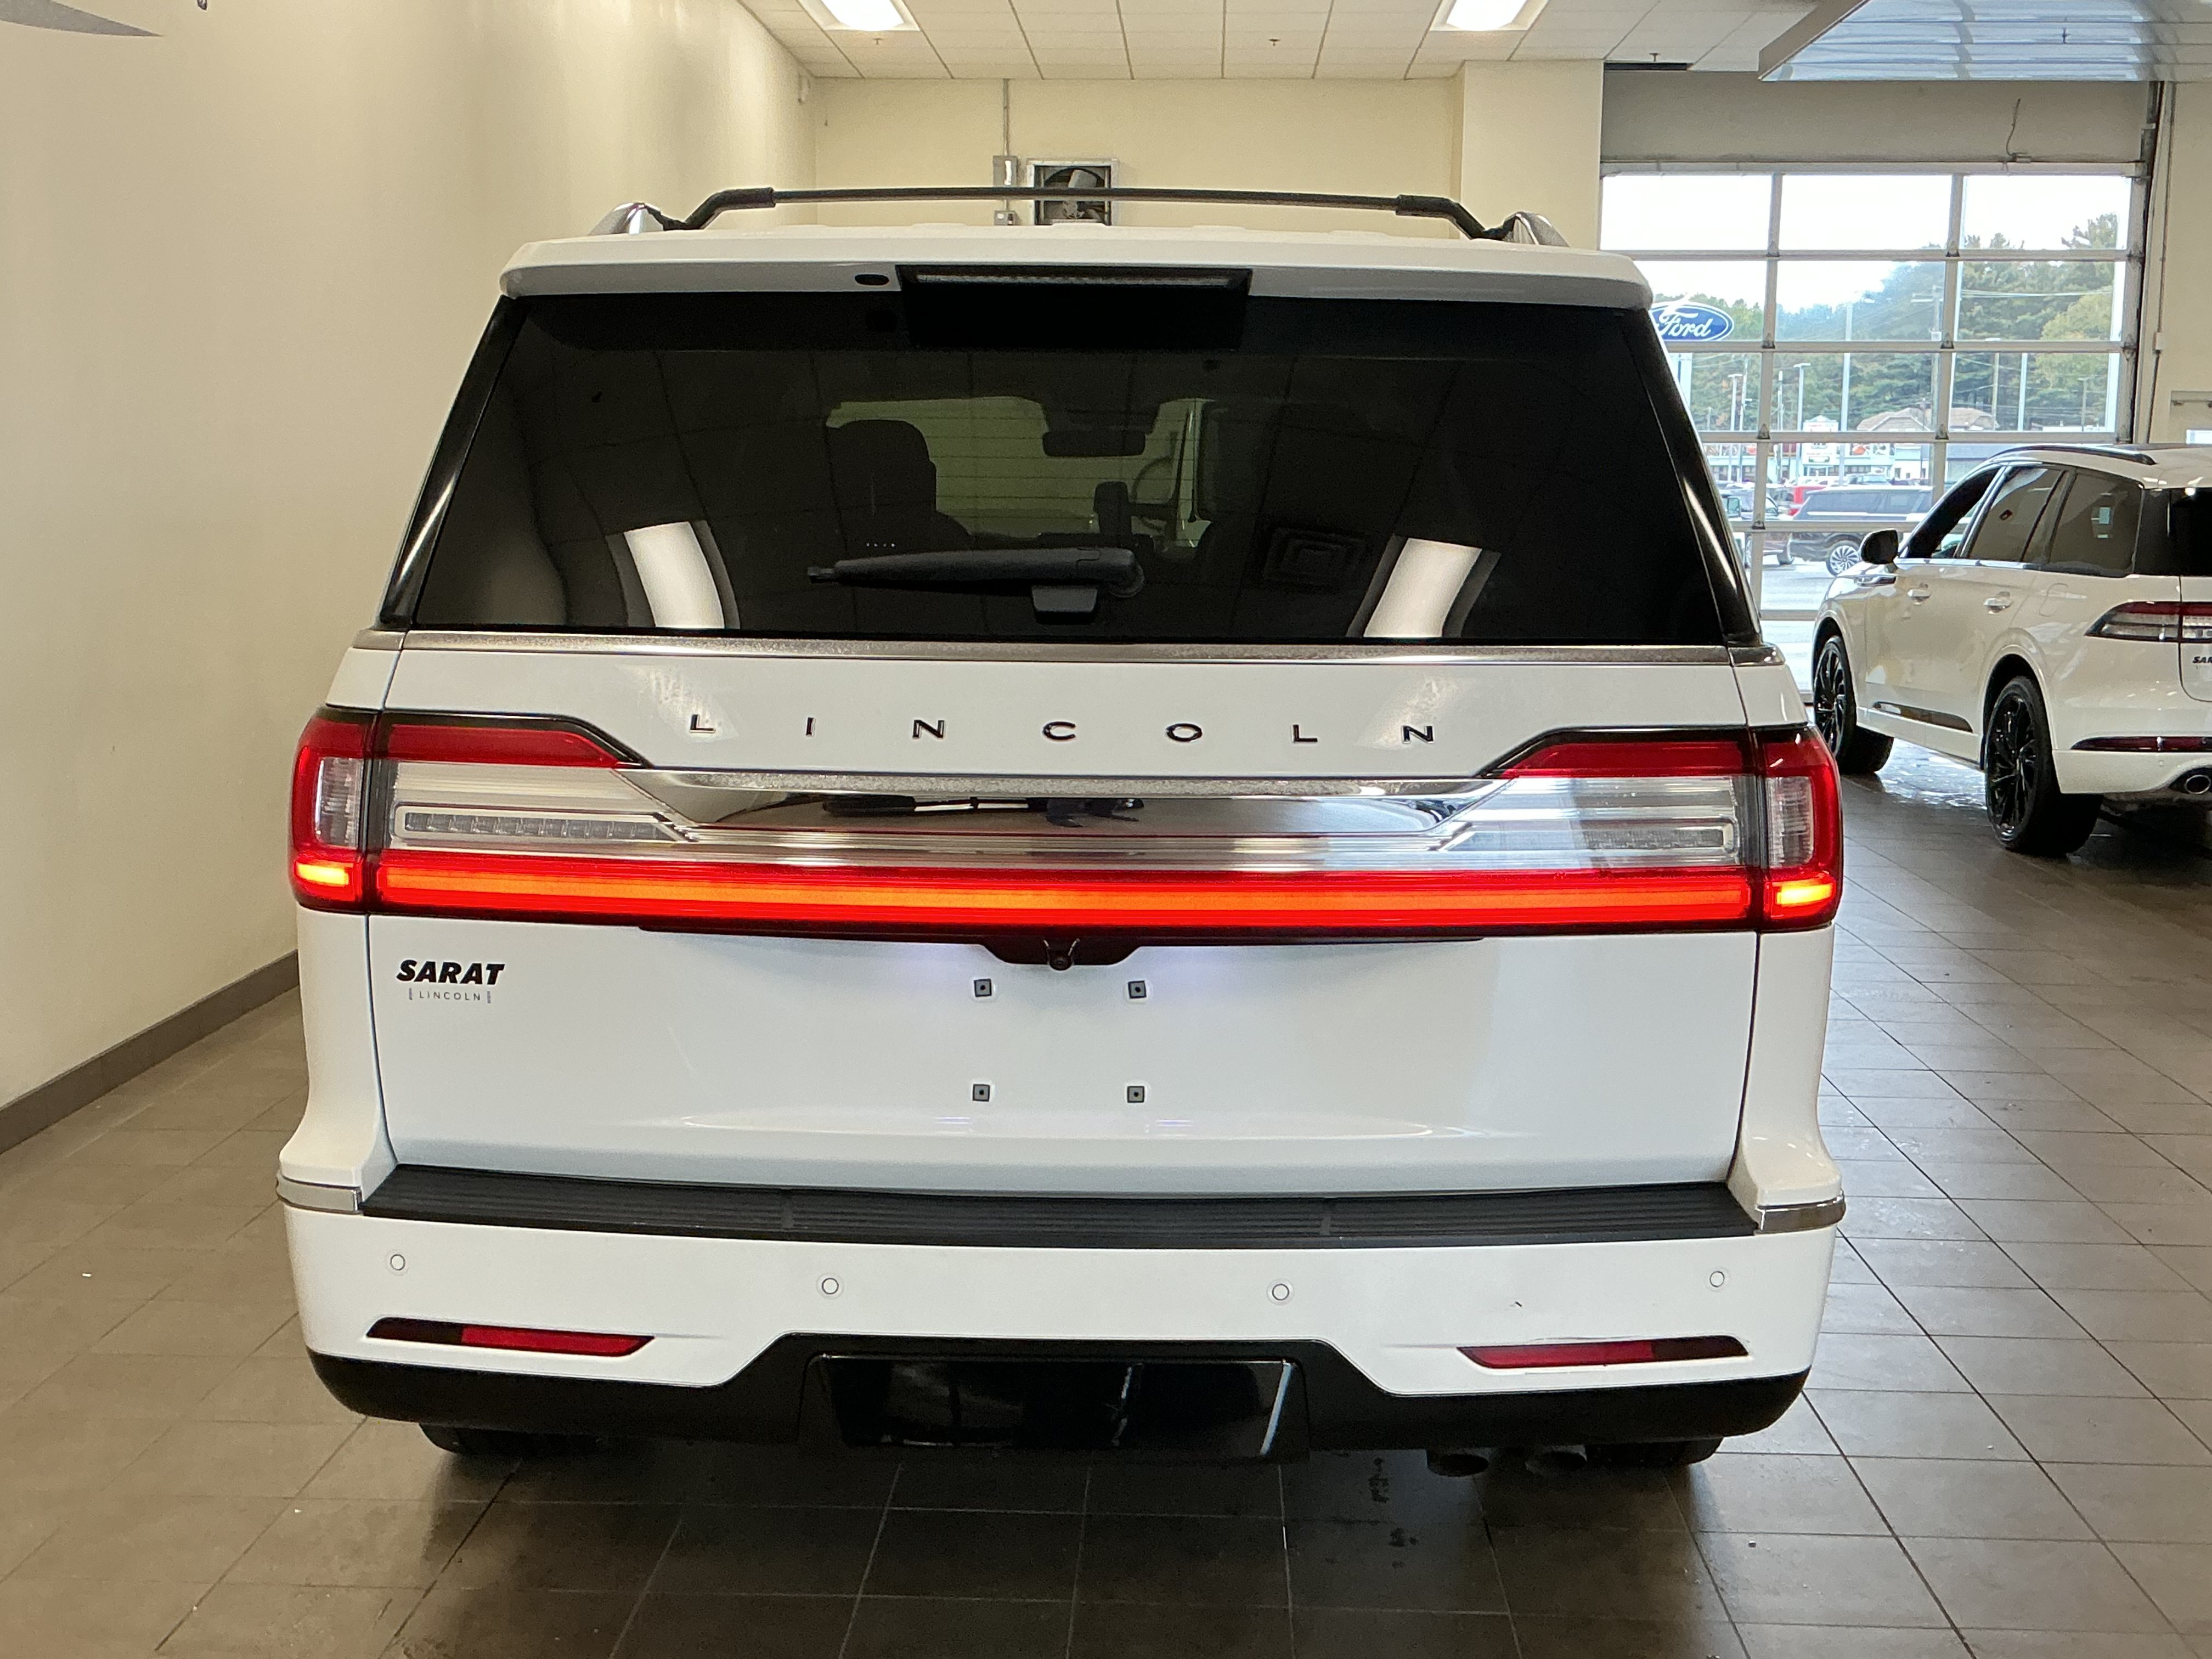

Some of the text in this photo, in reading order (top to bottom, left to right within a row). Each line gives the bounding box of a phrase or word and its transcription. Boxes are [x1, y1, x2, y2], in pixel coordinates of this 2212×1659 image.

[1657, 308, 1713, 337] Ford
[689, 714, 1435, 744] LINCOLN
[396, 959, 506, 985] SARAT
[419, 990, 481, 1001] LINCOLN
